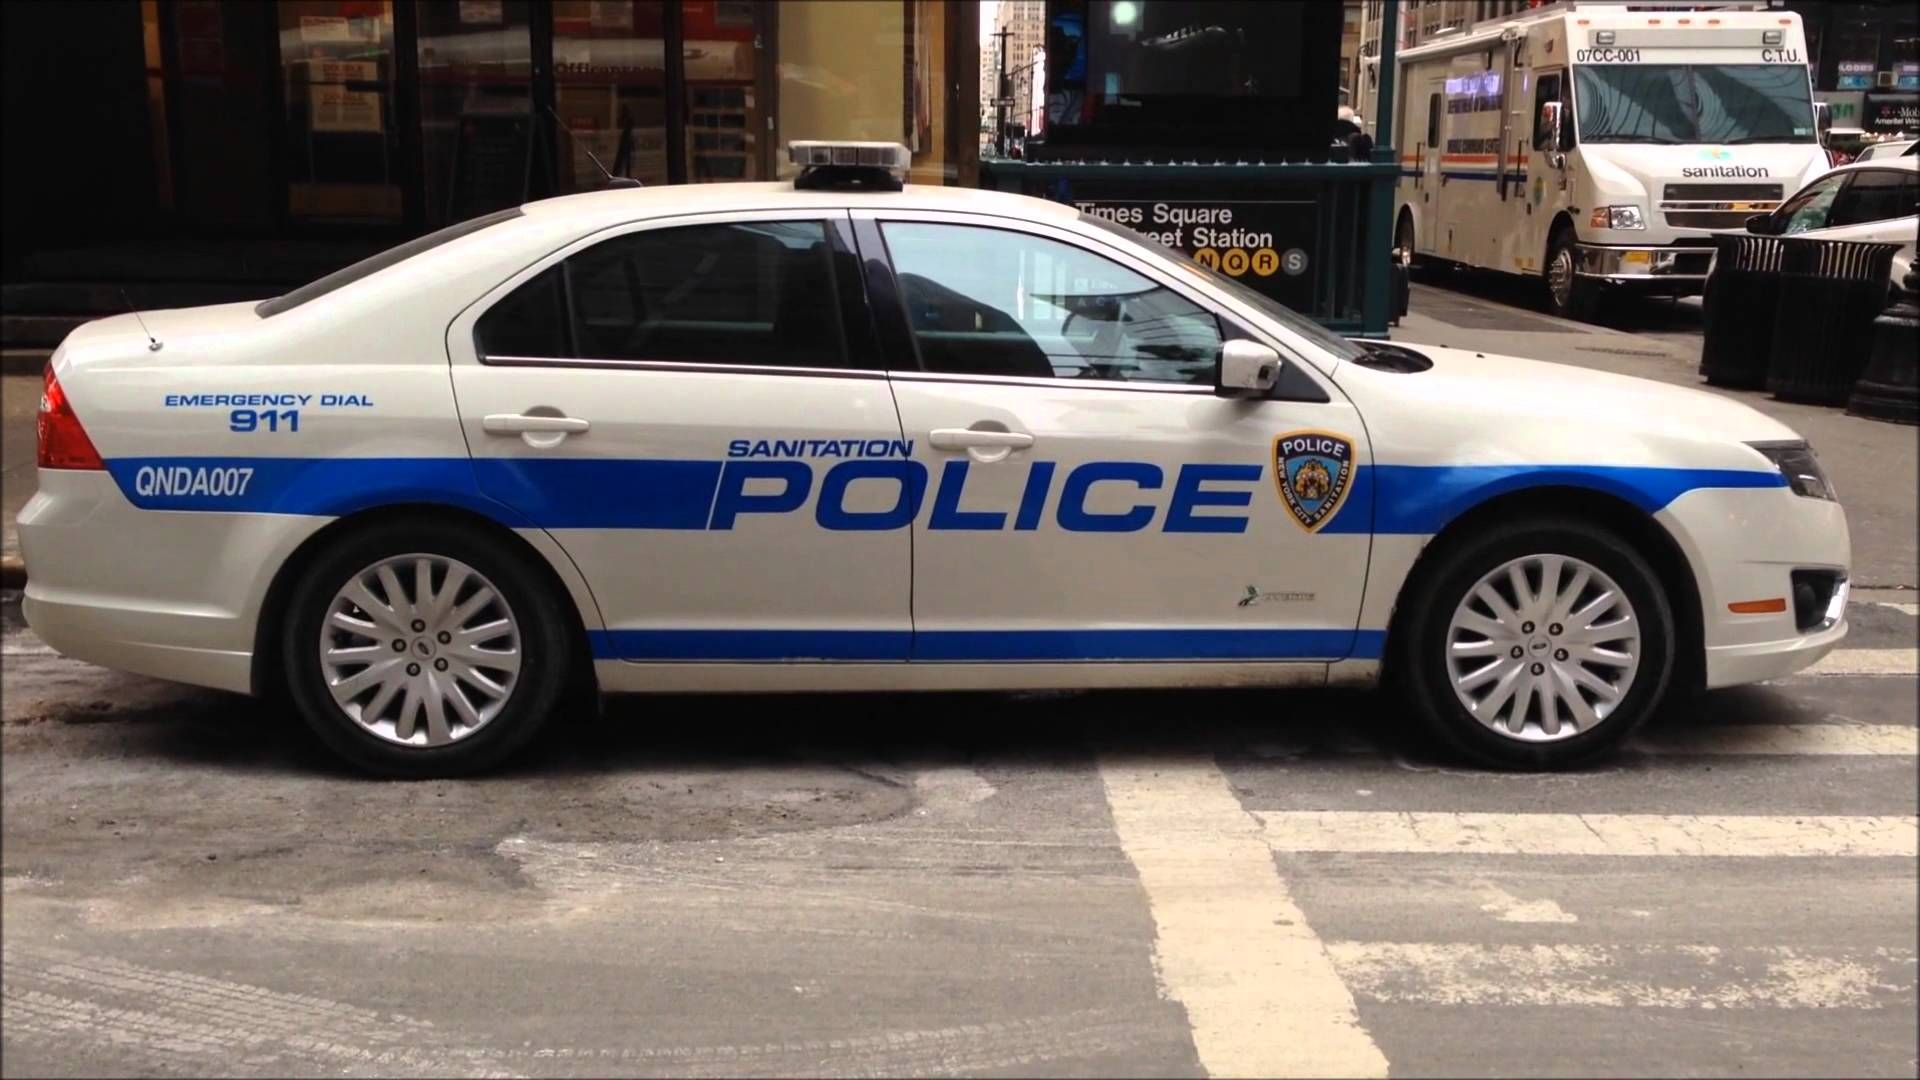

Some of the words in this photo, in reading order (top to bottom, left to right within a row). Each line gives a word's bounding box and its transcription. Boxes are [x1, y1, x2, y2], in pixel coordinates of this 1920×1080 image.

[1576, 48, 1641, 62] 07CC-001
[1761, 48, 1801, 62] C.T.U.
[1682, 165, 1769, 179] sanitation
[1075, 202, 1143, 223] Times
[1152, 202, 1233, 227] Square
[1192, 227, 1273, 248] Station
[1228, 254, 1243, 270] Q
[1259, 254, 1273, 270] R
[1287, 254, 1301, 270] S
[164, 394, 312, 407] EMERGENCY
[320, 394, 374, 407] DIAL
[229, 410, 299, 432] 911
[727, 439, 914, 458] SANITATION
[1282, 438, 1345, 457] POLICE
[1278, 456, 1287, 479] NEW
[136, 465, 254, 497] QNDA007
[1314, 459, 1350, 522] SANITATION
[709, 460, 1263, 533] POLICE
[1281, 481, 1298, 508] YORK
[1294, 506, 1312, 525] CITY
